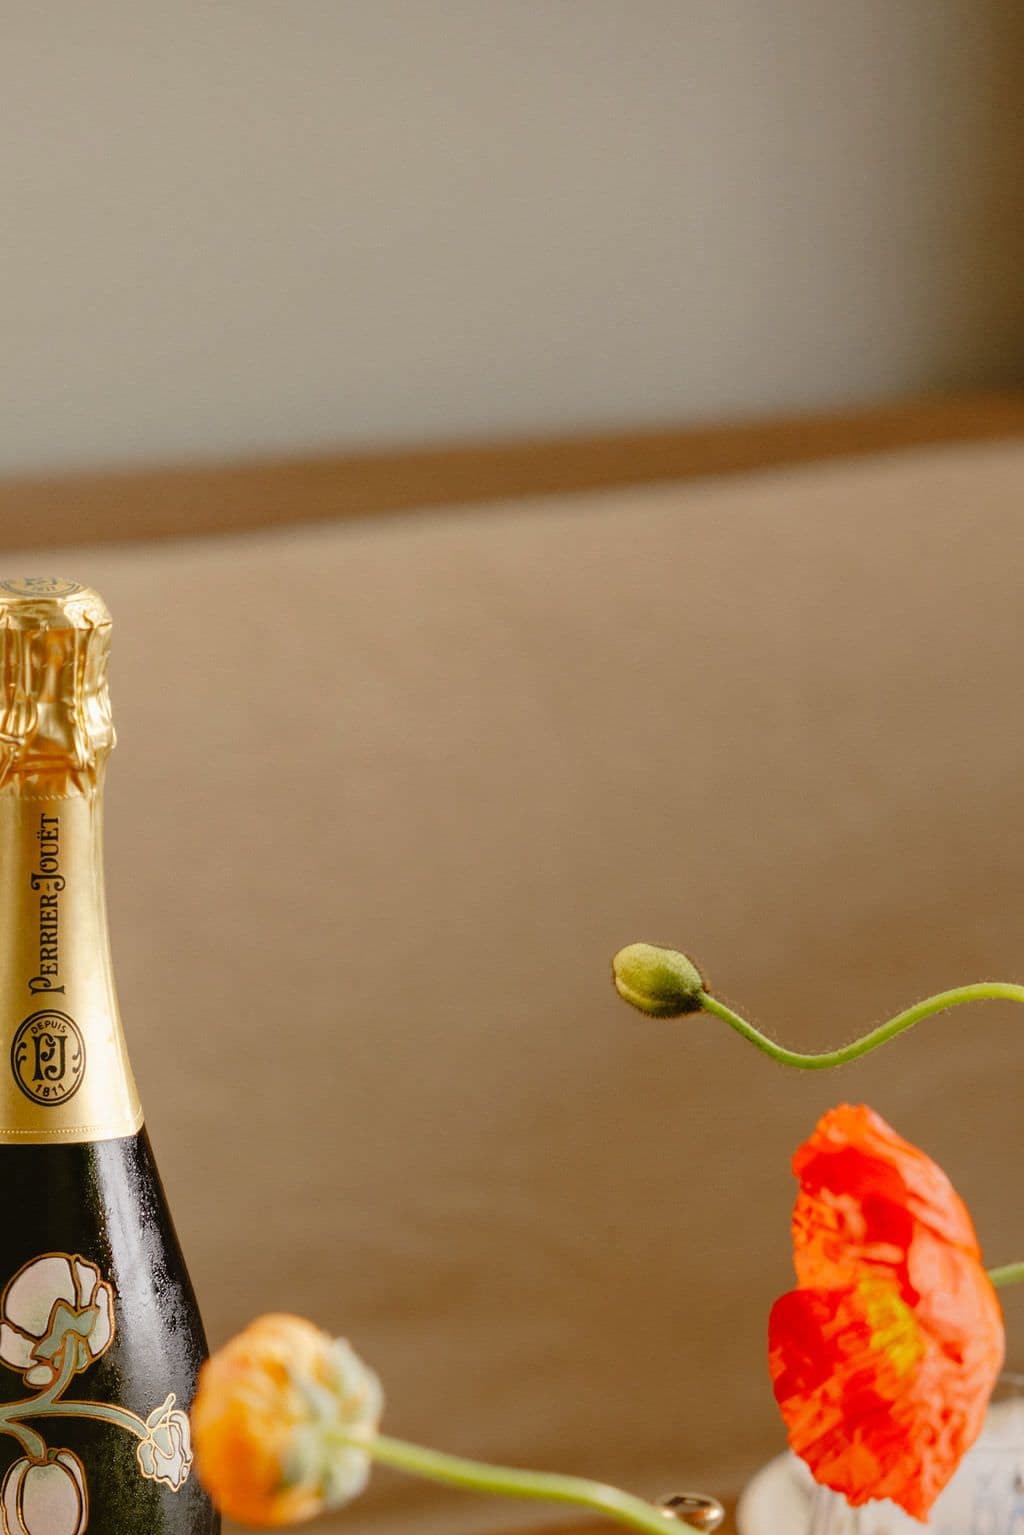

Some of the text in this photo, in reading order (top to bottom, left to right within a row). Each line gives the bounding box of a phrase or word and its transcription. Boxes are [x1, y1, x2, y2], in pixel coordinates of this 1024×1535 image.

[28, 812, 66, 997] PERRIER-JOUËT
[30, 1020, 67, 1034] DEPUIS
[35, 1083, 65, 1097] 1811
